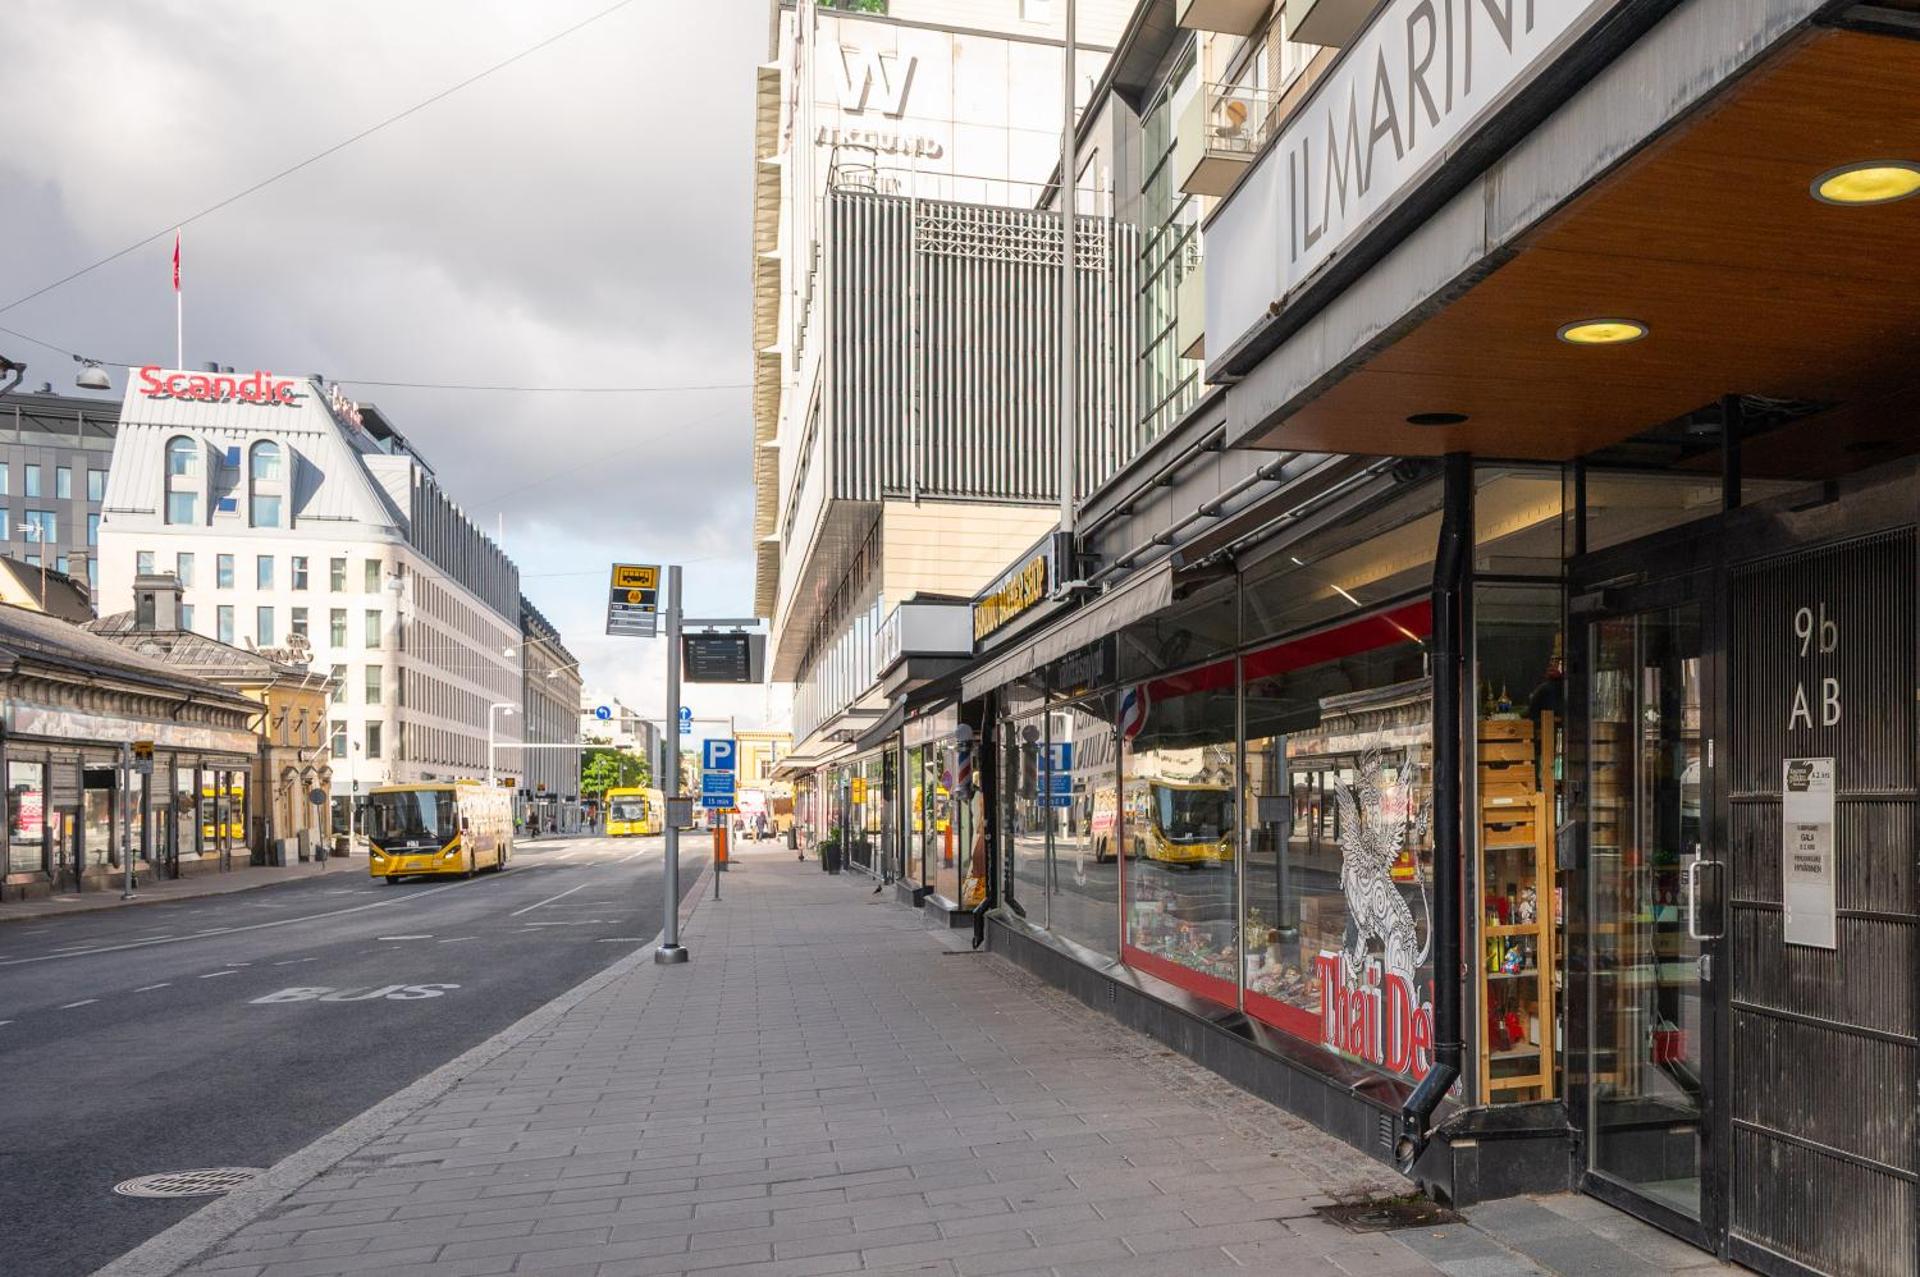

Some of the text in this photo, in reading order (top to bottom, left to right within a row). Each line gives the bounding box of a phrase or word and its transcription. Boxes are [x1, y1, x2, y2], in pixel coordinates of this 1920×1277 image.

[139, 364, 296, 403] Scandic
[1795, 602, 1838, 657] 9b
[1788, 677, 1841, 730] A B
[709, 741, 731, 769] P
[248, 983, 462, 1004] BUS
[1315, 949, 1435, 1081] Thai De
